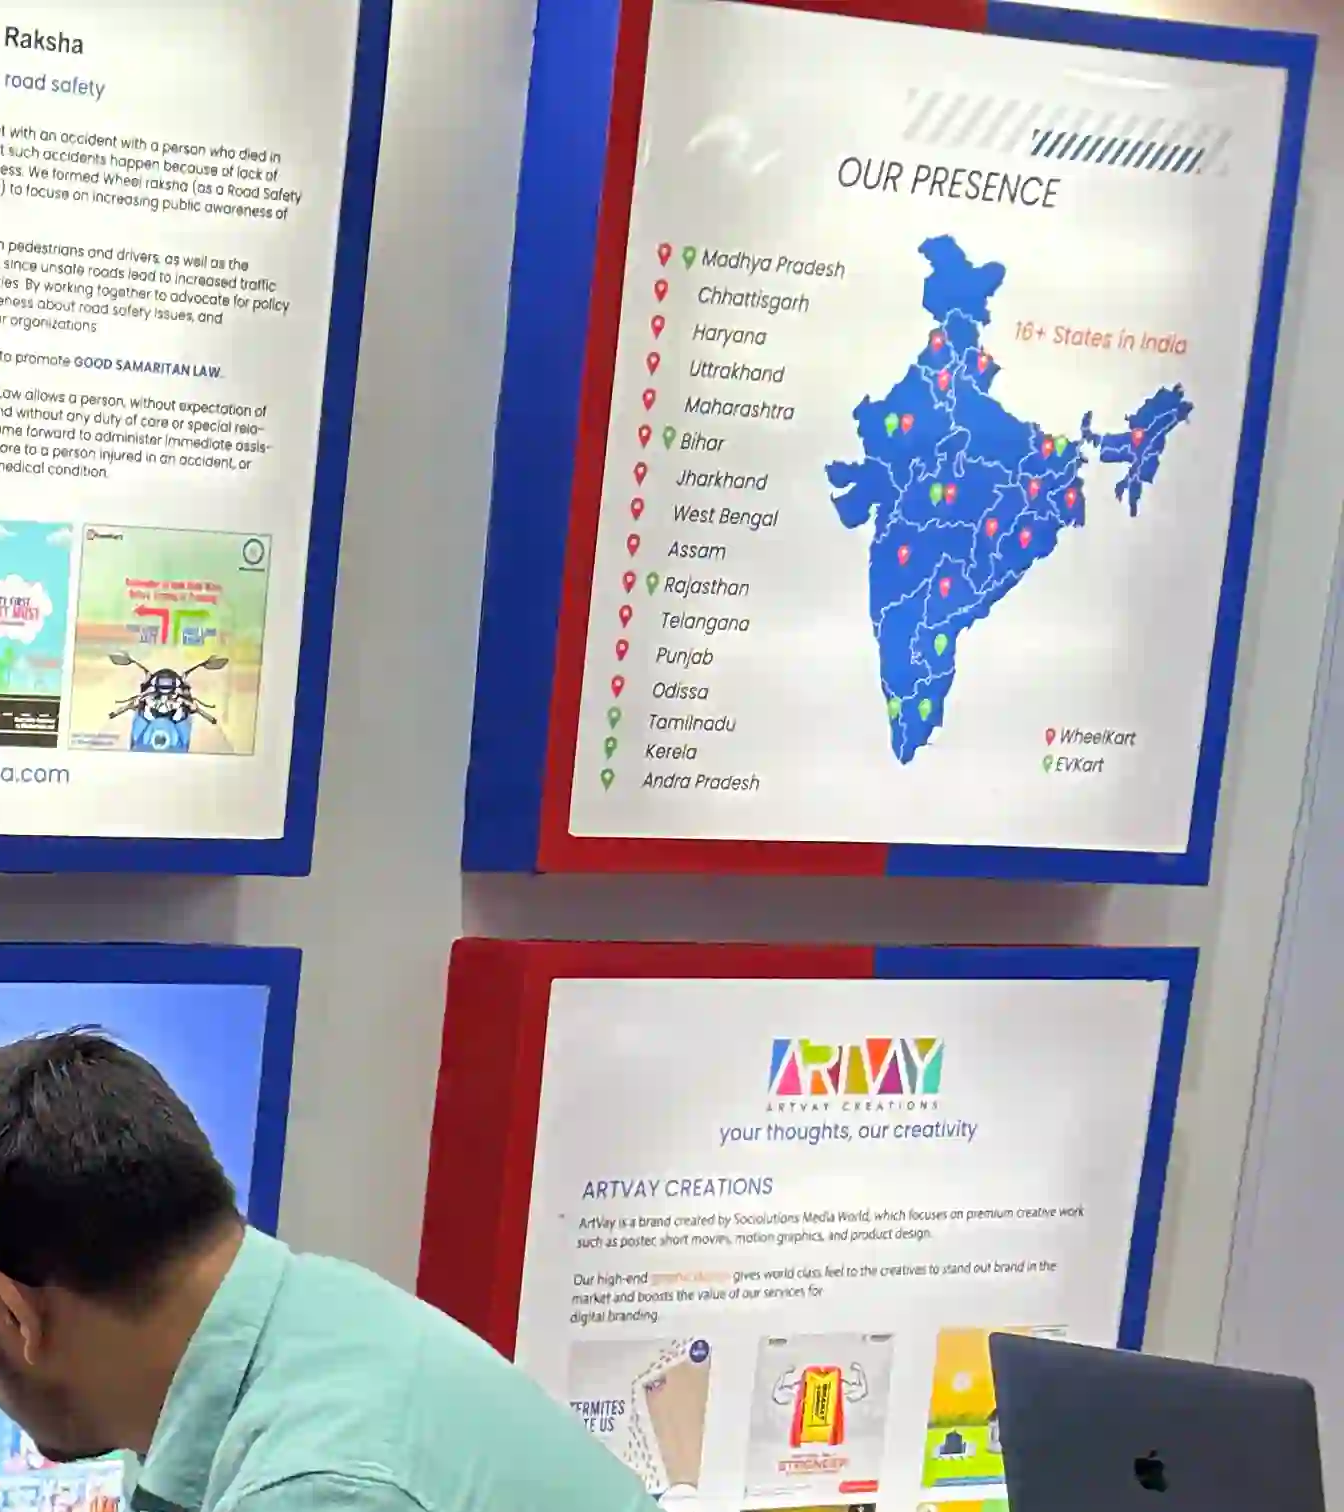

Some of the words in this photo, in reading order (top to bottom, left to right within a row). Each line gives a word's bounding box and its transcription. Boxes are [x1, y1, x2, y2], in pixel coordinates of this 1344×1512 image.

[5, 26, 83, 54] Raksha
[5, 74, 46, 90] road
[52, 76, 105, 102] safety
[838, 157, 903, 192] OUR
[911, 164, 1061, 208] PRESENCE
[702, 249, 772, 276] Madhya
[775, 256, 845, 278] Pradesh
[698, 286, 809, 315] Chhattisgarh
[692, 324, 767, 348] Haryana
[1016, 321, 1046, 341] 16+
[1053, 326, 1113, 350] States
[1118, 328, 1135, 351] in
[1140, 332, 1187, 355] India
[0, 351, 12, 362] to
[16, 354, 70, 367] promote
[74, 356, 112, 369] GOOD
[116, 360, 190, 376] SAMARITAN
[690, 360, 785, 383] Uttrakhand
[684, 396, 794, 420] Maharashtra
[680, 433, 725, 452] Bihar
[676, 470, 768, 490] Jharkhand
[675, 505, 716, 524] West
[719, 508, 779, 531] Bengal
[668, 541, 726, 560] Assam
[665, 576, 749, 599] Rajasthan
[662, 612, 750, 635] Telangana
[656, 647, 713, 669] Punjab
[653, 682, 708, 700] Odissa
[650, 714, 736, 732] Tamilnadu
[1059, 728, 1137, 746] WheelKart
[646, 744, 697, 760] Kerela
[1056, 754, 1105, 773] EVKart
[642, 772, 692, 788] Andra
[695, 774, 760, 790] Pradesh
[766, 1102, 829, 1112] ARTVAY
[842, 1100, 937, 1111] CREATIONS
[720, 1128, 762, 1147] your
[767, 1122, 852, 1145] thoughts,
[858, 1125, 890, 1138] our
[894, 1120, 978, 1142] creativity
[582, 1180, 660, 1200] ARTVAY
[665, 1178, 773, 1197] CREATIONS
[570, 1310, 605, 1327] digital
[600, 1417, 615, 1433] US
